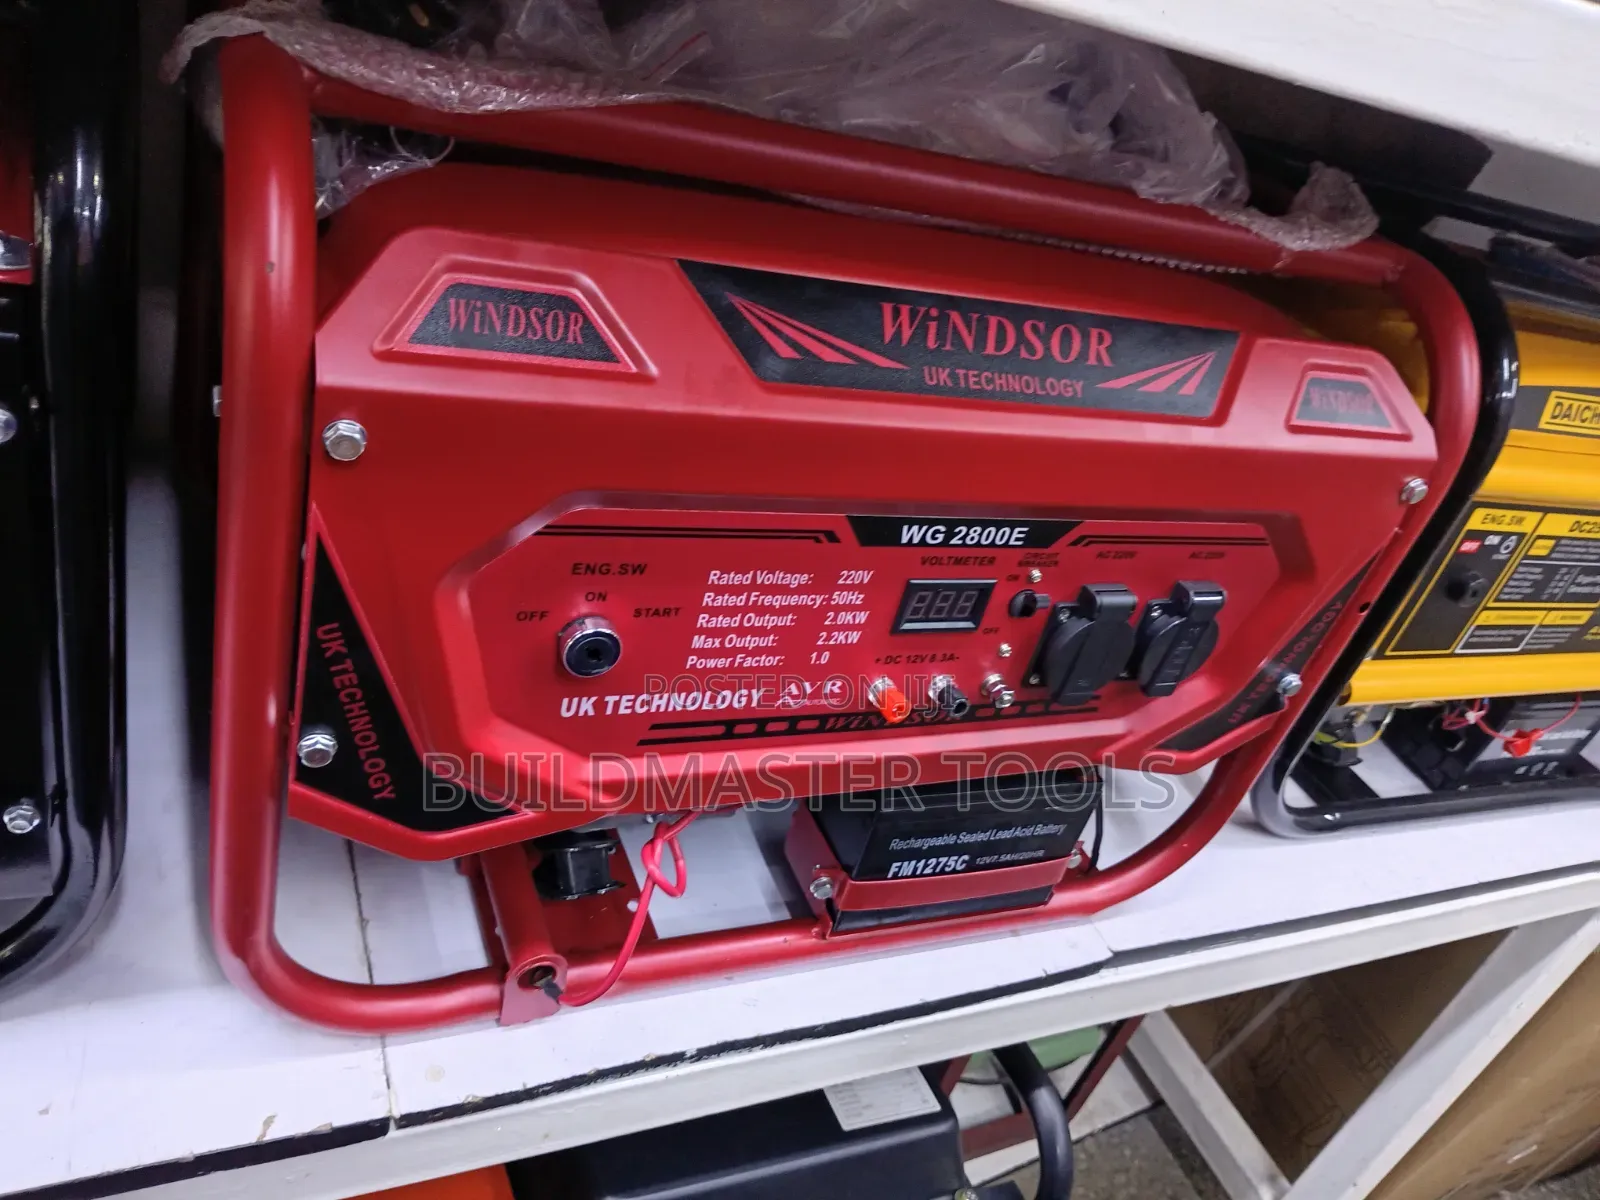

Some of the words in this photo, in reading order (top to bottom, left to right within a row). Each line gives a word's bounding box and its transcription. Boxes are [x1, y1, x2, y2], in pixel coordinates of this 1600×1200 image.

[879, 302, 1115, 367] WiNDSOR
[922, 365, 952, 387] UK
[955, 368, 1084, 398] TECHNOLOGY
[900, 524, 947, 545] WG
[949, 526, 1029, 546] 2800E
[571, 562, 648, 576] ENG.SW
[920, 555, 998, 567] VOLTMETER
[707, 570, 753, 585] Rated
[755, 570, 815, 588] Voltage:
[837, 569, 875, 585] 220V
[584, 591, 608, 602] ON
[702, 592, 748, 607] Rated
[748, 591, 829, 609] Frequency:
[830, 591, 866, 606] 50Hz
[515, 610, 550, 622] OFF
[632, 606, 682, 618] START
[696, 613, 742, 628] Rated
[743, 612, 798, 630] Output:
[824, 610, 870, 626] 2.0KW
[316, 621, 348, 659] UK
[691, 634, 722, 649] Max
[724, 633, 779, 650] Output:
[816, 631, 862, 646] 2.2KW
[686, 655, 734, 670] Power
[734, 654, 786, 669] Factor:
[809, 651, 831, 665] 1.0
[883, 654, 903, 665] DC
[905, 653, 930, 665] 12V
[559, 696, 598, 718] UK
[604, 688, 767, 716] TECHNOLOGY
[328, 658, 396, 801] TECHNOLOGY
[889, 831, 957, 851] Rechargeable
[956, 829, 990, 845] Sealed
[1033, 822, 1068, 838] Battery
[887, 854, 971, 879] FM1275C
